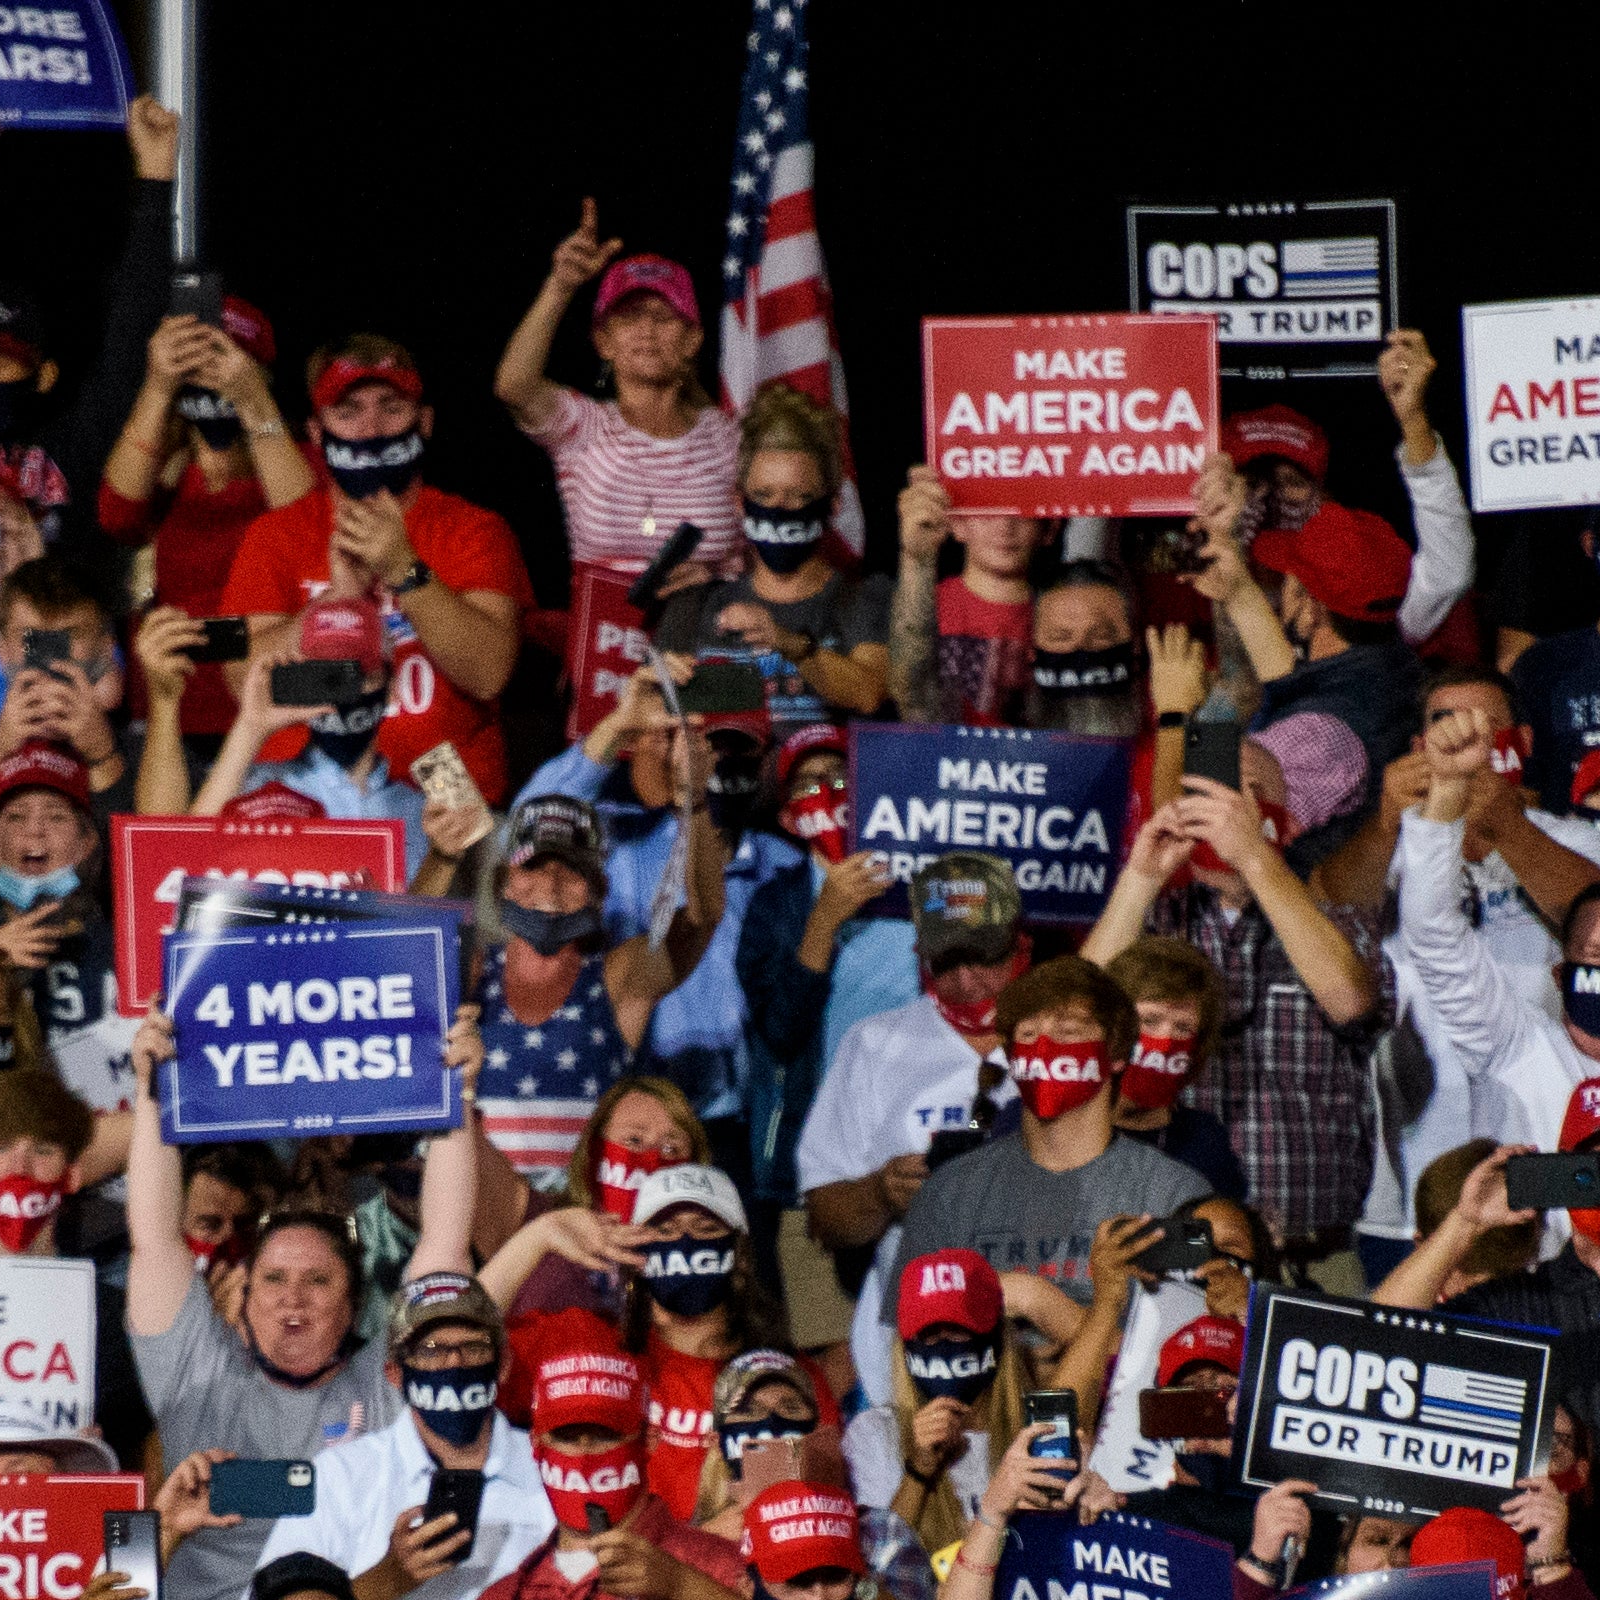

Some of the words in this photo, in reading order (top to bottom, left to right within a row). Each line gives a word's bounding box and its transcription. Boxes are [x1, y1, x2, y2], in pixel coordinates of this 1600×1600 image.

[1148, 242, 1280, 298] COPS
[1251, 309, 1375, 336] TRUMP
[1014, 349, 1127, 381] MAKE
[942, 388, 1203, 437] AMERICA
[943, 446, 1066, 481] GREAT
[1079, 443, 1206, 476] AGAIN
[937, 758, 1048, 796] MAKE
[863, 798, 1111, 854] AMERICA
[196, 983, 234, 1028] 4
[248, 974, 415, 1025] MORE
[205, 1036, 414, 1088] YEARS!
[1009, 1055, 1101, 1082] MAGA
[646, 1249, 734, 1278] MAGA
[908, 1351, 996, 1380] MAGA
[1276, 1338, 1419, 1422] COPS
[408, 1382, 496, 1412] MAGA
[1279, 1415, 1361, 1452] FOR
[1379, 1430, 1512, 1479] TRUMP
[542, 1459, 639, 1492] MAGA
[1074, 1539, 1170, 1588] MAKE
